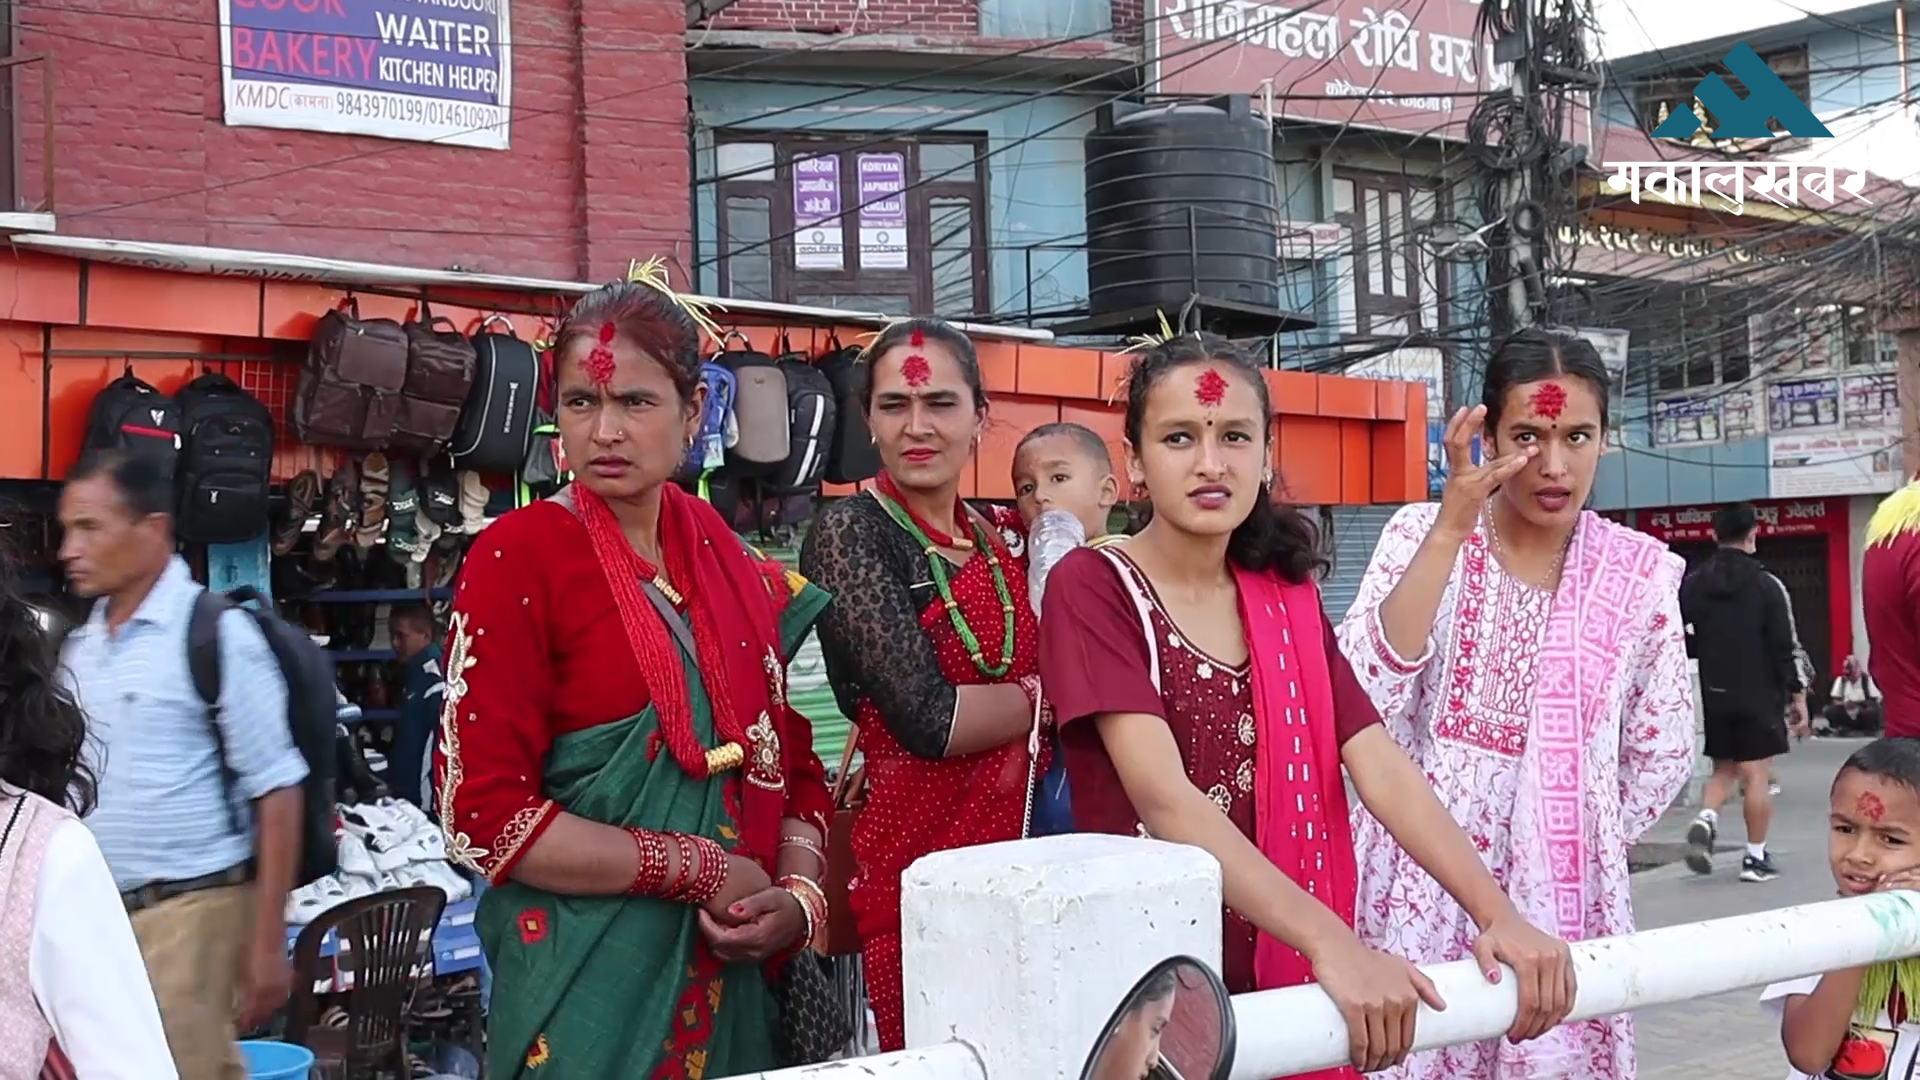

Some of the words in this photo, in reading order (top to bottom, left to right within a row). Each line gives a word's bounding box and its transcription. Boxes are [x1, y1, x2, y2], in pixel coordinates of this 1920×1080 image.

[232, 26, 378, 82] BAKERY
[375, 11, 492, 57] WAITER
[1428, 32, 1477, 84] घर
[379, 56, 444, 88] KITCHEN
[449, 64, 498, 95] HELPER
